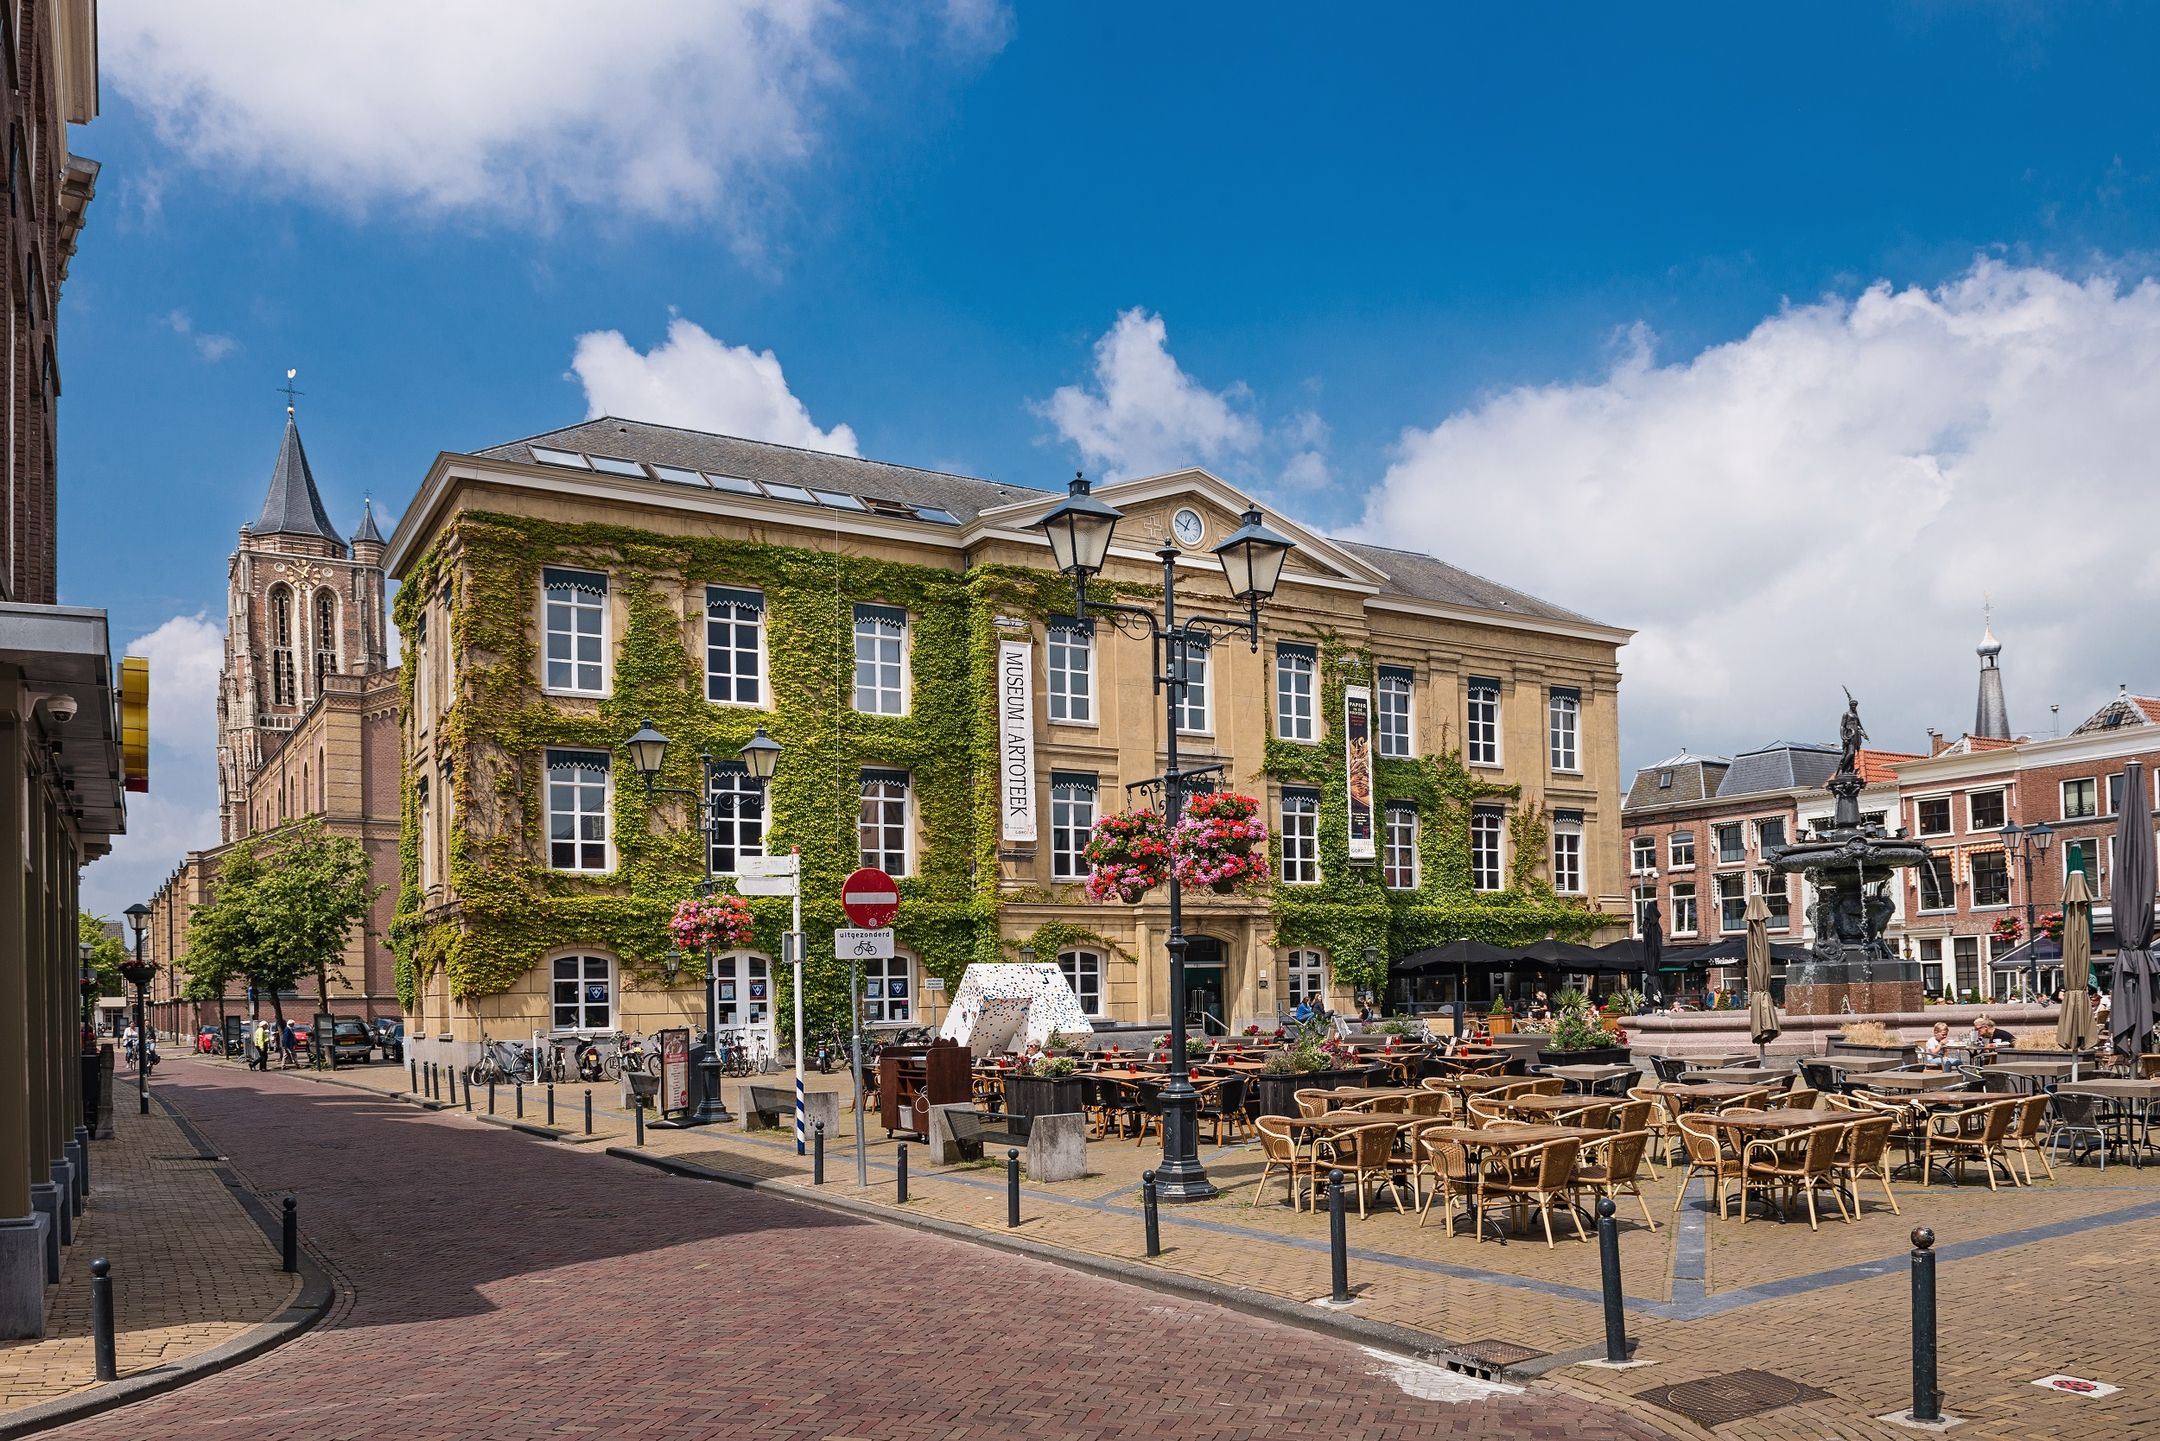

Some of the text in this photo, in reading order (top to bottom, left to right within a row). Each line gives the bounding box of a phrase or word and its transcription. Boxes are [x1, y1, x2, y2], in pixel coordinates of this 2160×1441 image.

[1005, 652, 1025, 720] MUSEUM
[1008, 733, 1028, 817] ARTOTEEK
[839, 931, 890, 939] uitgezonderd
